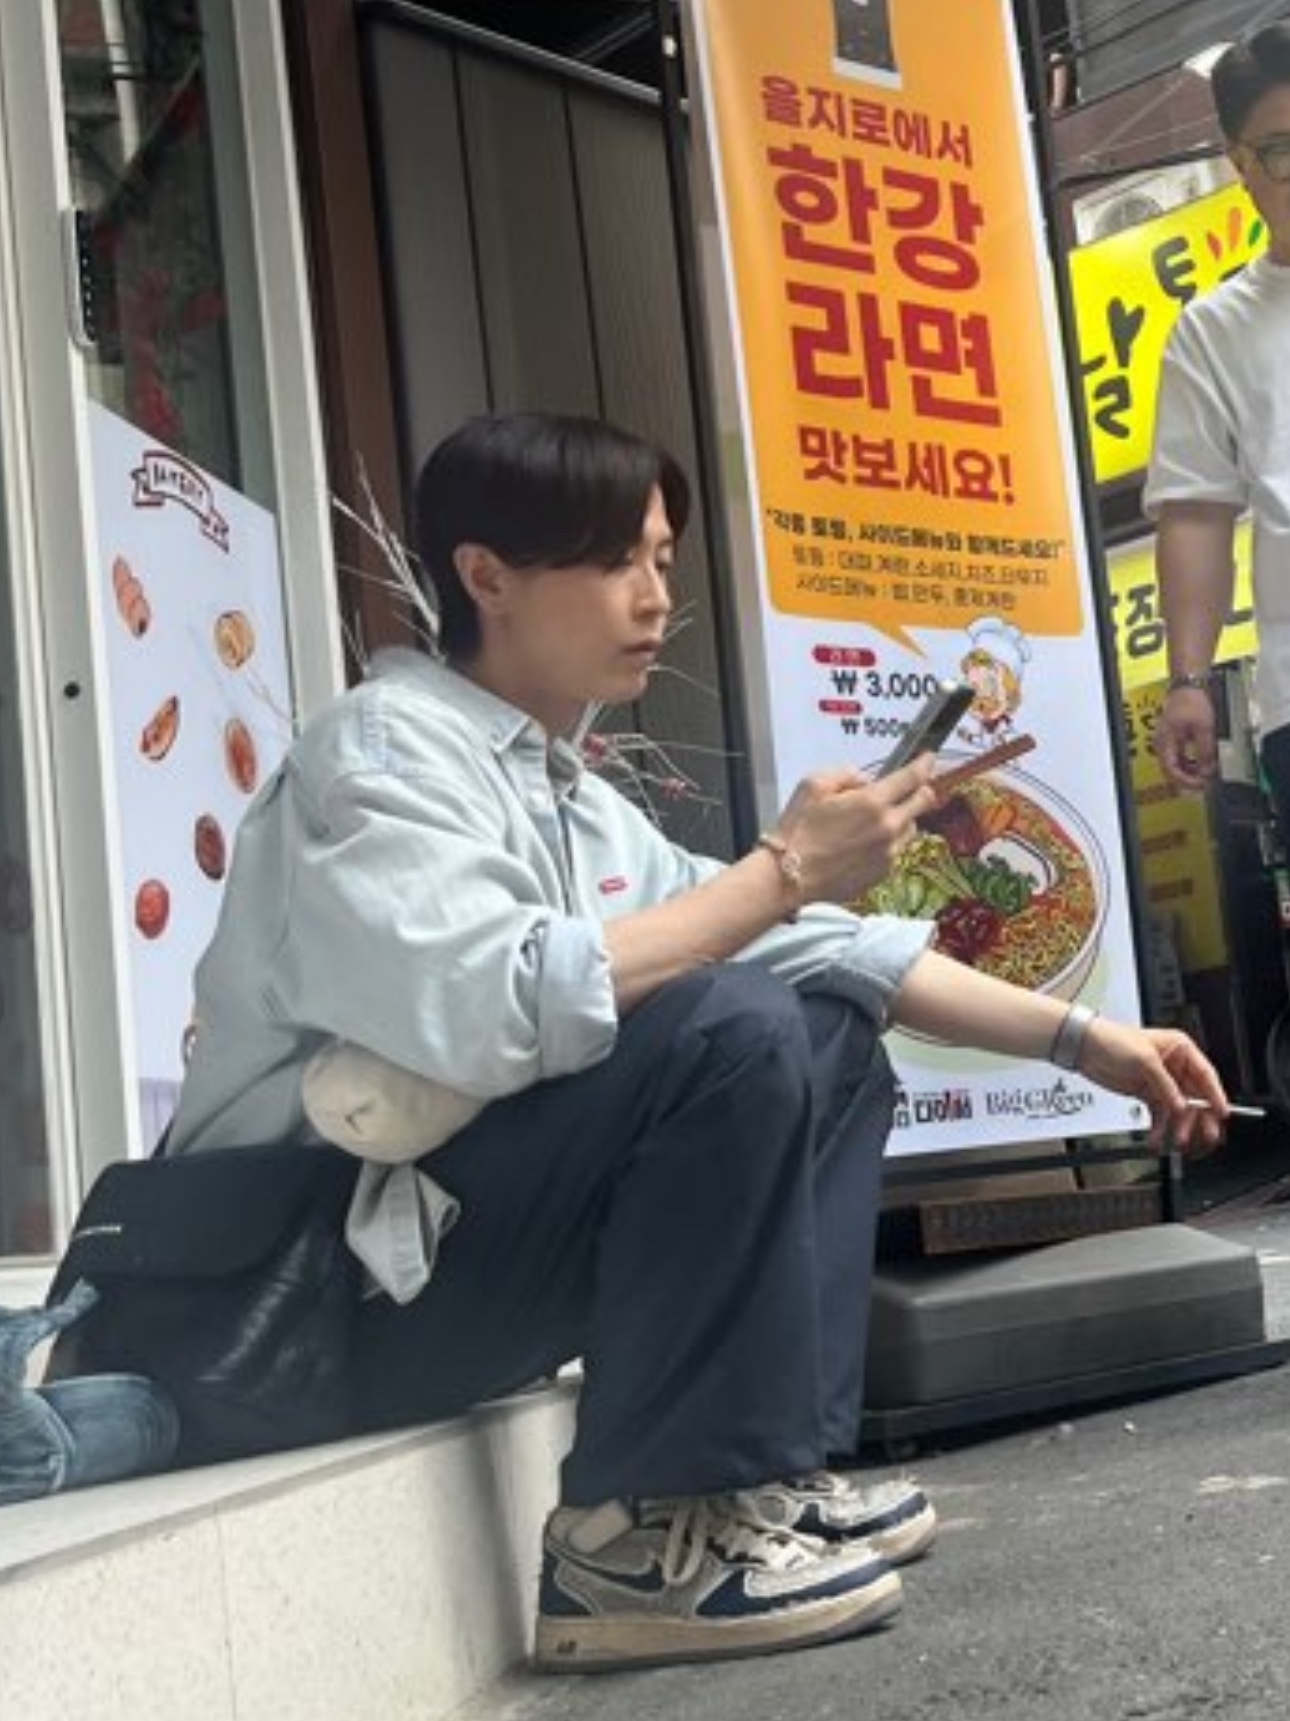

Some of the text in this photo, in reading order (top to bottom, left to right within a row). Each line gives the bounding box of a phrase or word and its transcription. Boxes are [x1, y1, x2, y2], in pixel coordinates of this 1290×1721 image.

[762, 75, 973, 170] 을지로에서
[766, 143, 985, 292] 한강
[786, 280, 1003, 429] 라면
[798, 424, 1016, 507] 맛보세요!
